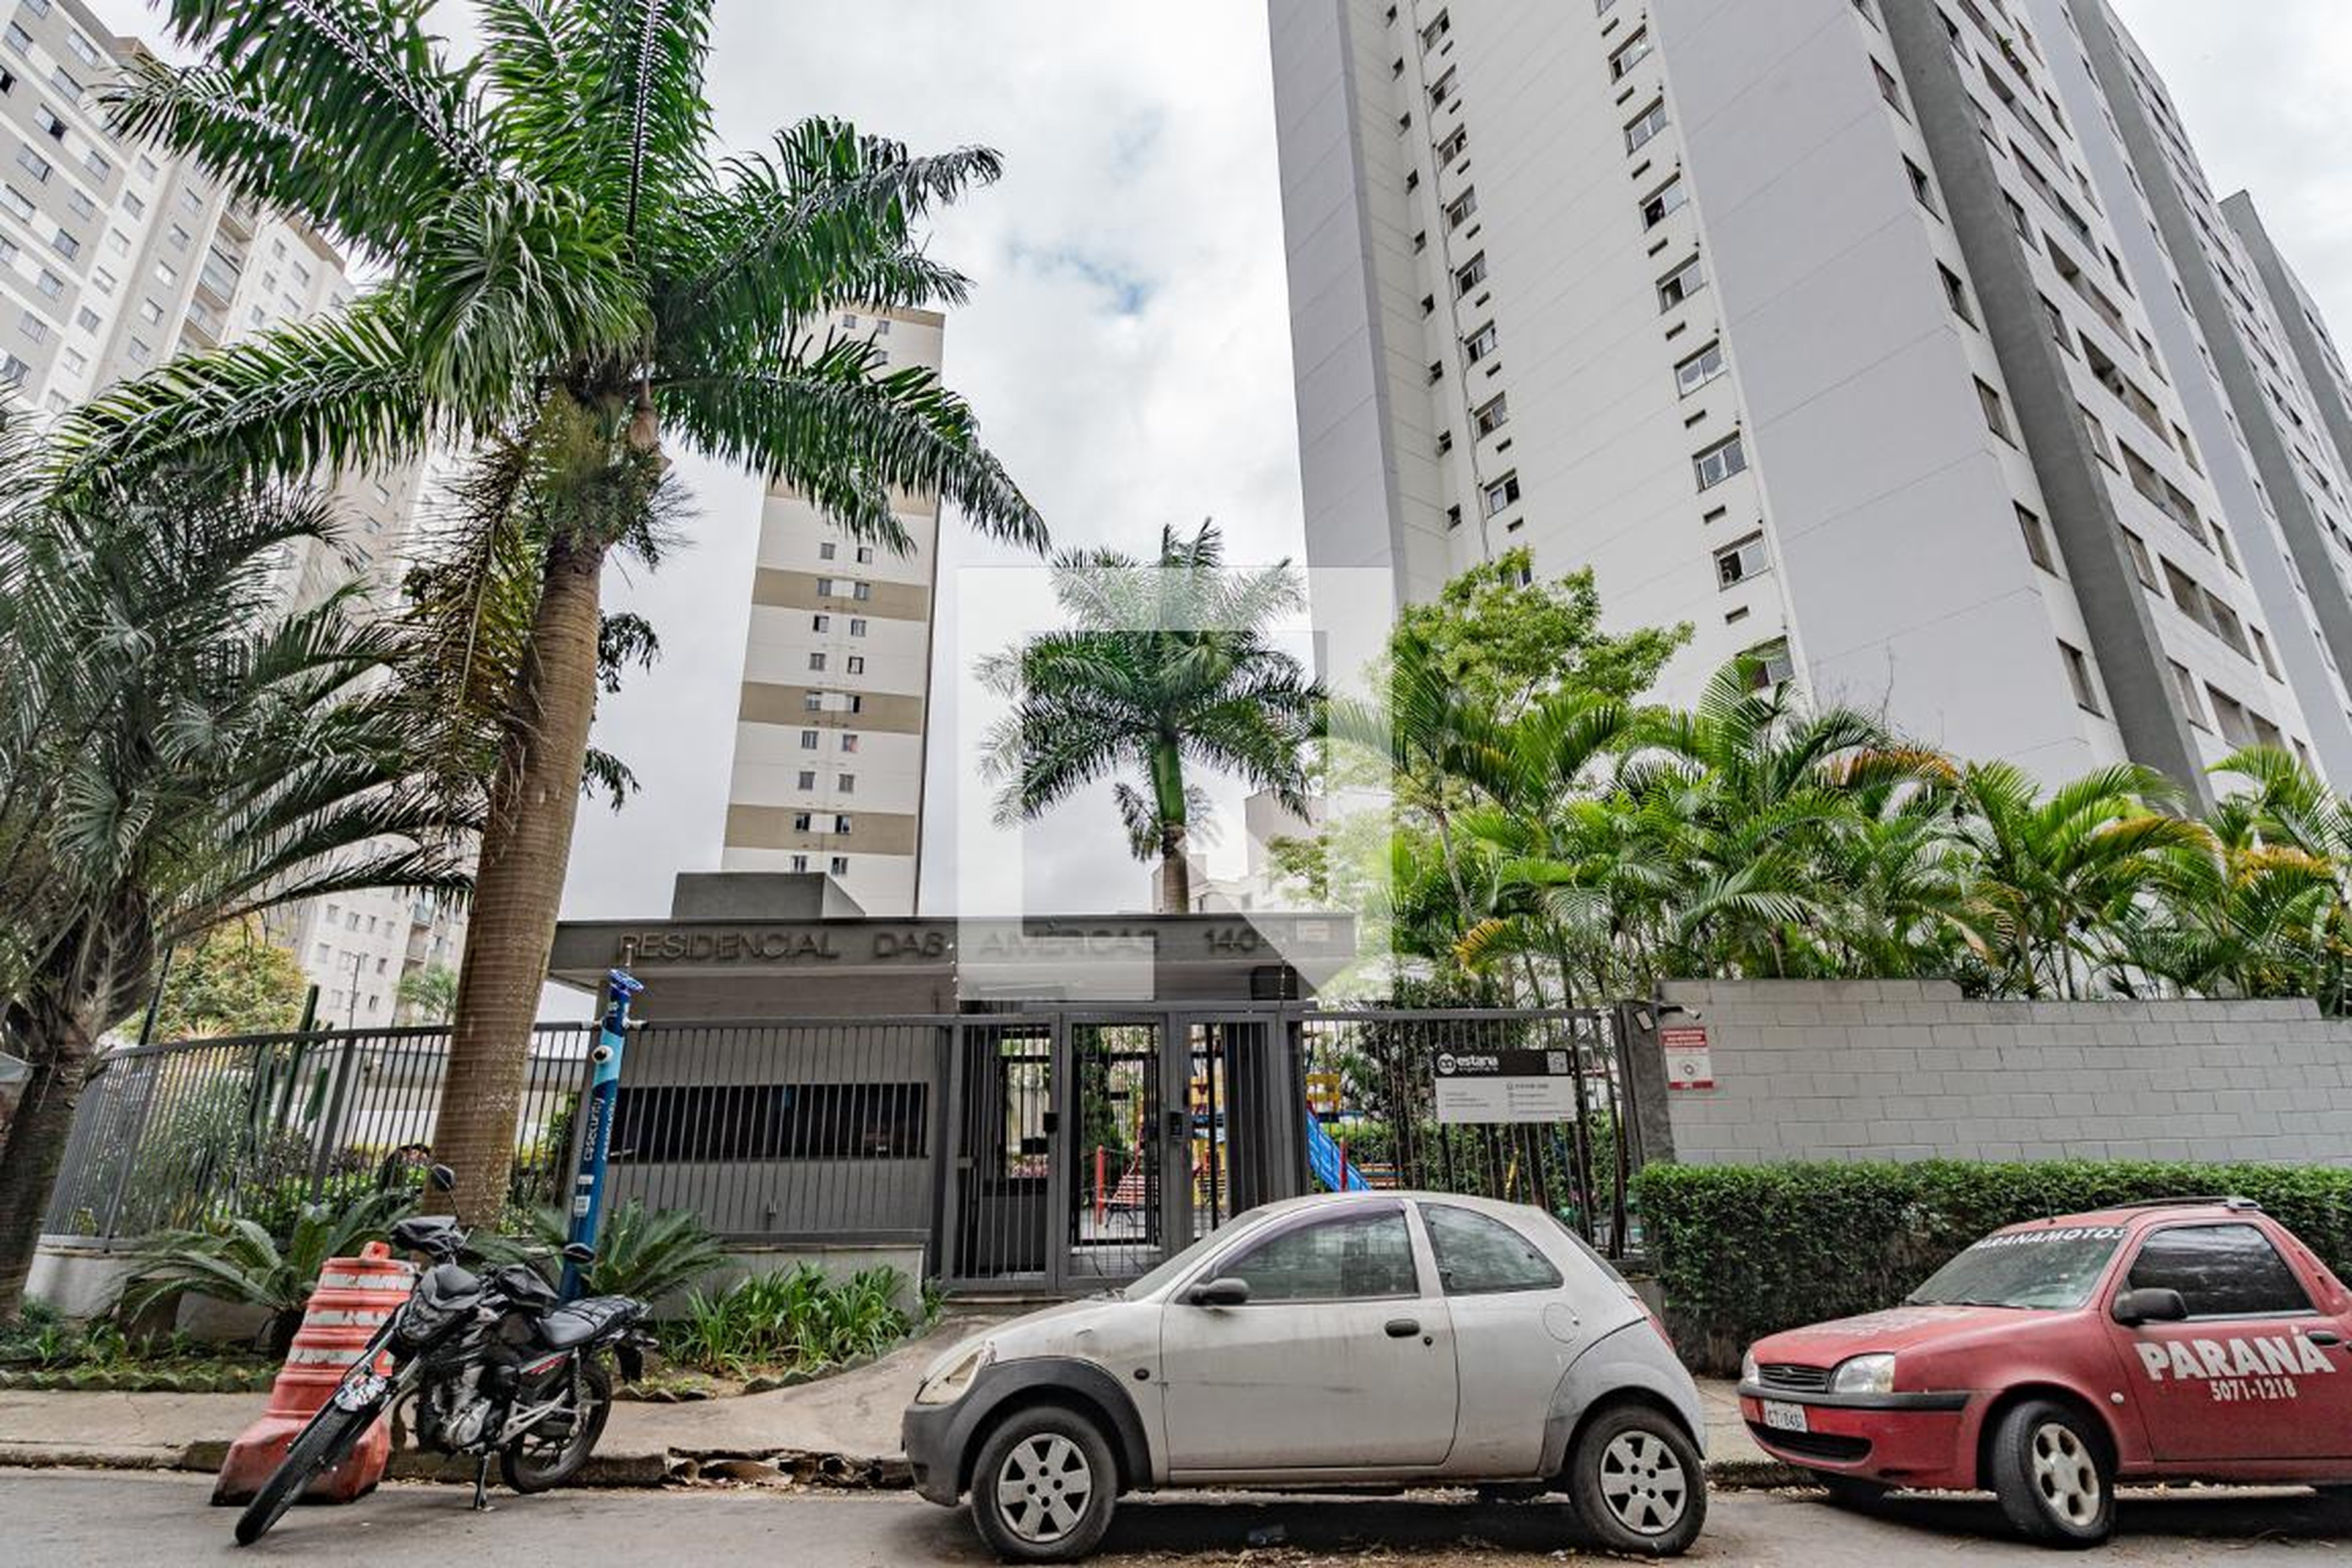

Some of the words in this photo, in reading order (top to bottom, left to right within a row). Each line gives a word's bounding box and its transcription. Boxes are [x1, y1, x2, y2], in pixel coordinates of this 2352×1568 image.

[872, 931, 945, 959] DAS
[1978, 1227, 2127, 1249] ARANAMOTOS
[2134, 1324, 2336, 1381] PARANÁ
[2209, 1378, 2297, 1402] 5071-1218
